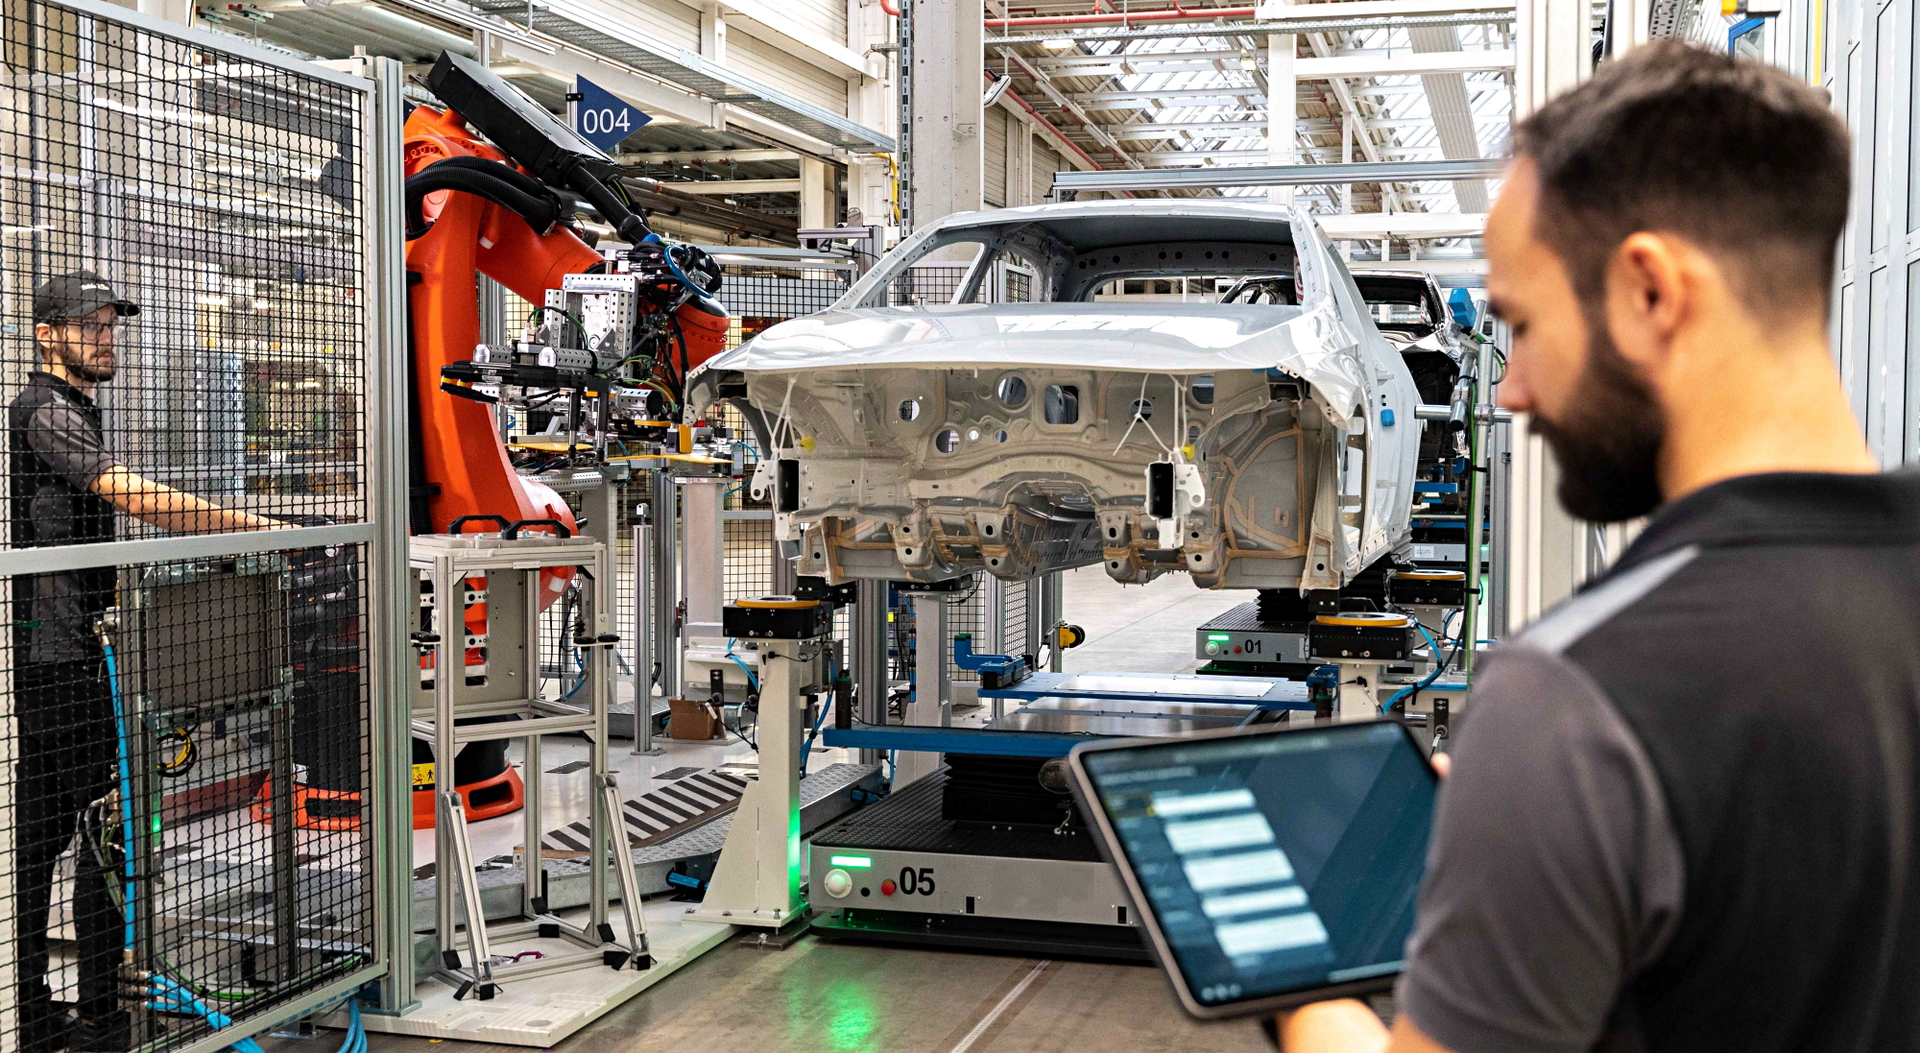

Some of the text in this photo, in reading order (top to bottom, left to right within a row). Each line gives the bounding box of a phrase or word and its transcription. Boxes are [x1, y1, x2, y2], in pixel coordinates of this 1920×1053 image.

[583, 107, 631, 134] 004
[1244, 639, 1262, 654] 01
[899, 866, 936, 896] 05
